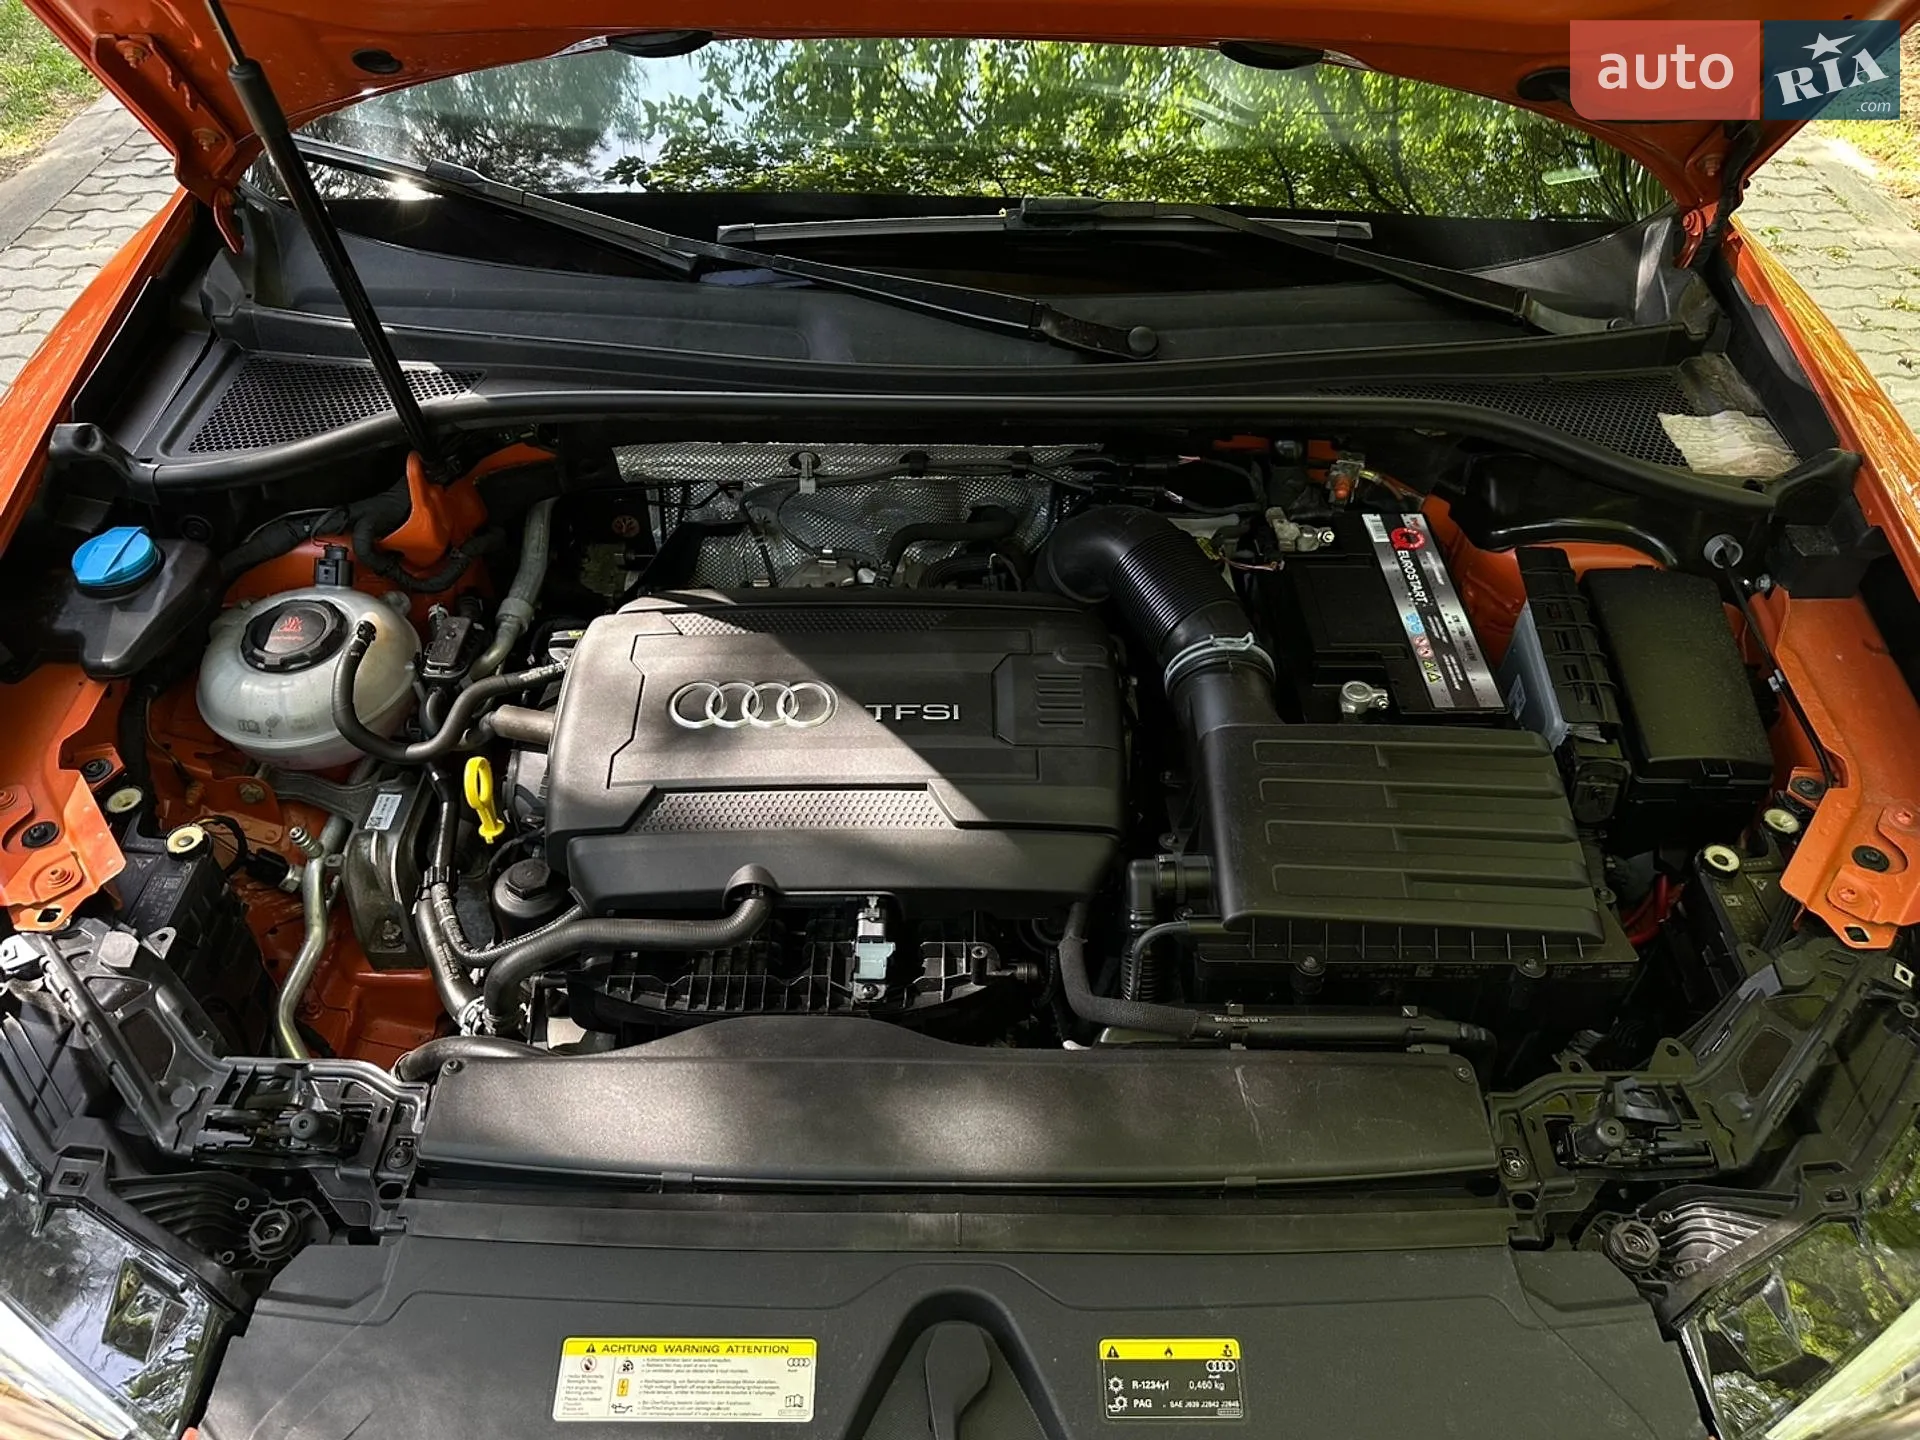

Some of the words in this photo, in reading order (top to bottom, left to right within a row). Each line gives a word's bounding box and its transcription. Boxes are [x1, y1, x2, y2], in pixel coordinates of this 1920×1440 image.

[1397, 549, 1428, 603] EUROSTART
[865, 704, 959, 720] TFSI
[602, 1343, 657, 1353] ACHTUNG
[664, 1343, 720, 1353] WARNING
[725, 1343, 789, 1353] ATTENTION
[1131, 1380, 1169, 1391] R-1234yf
[1214, 1380, 1225, 1391] kg
[1133, 1399, 1152, 1408] PAG
